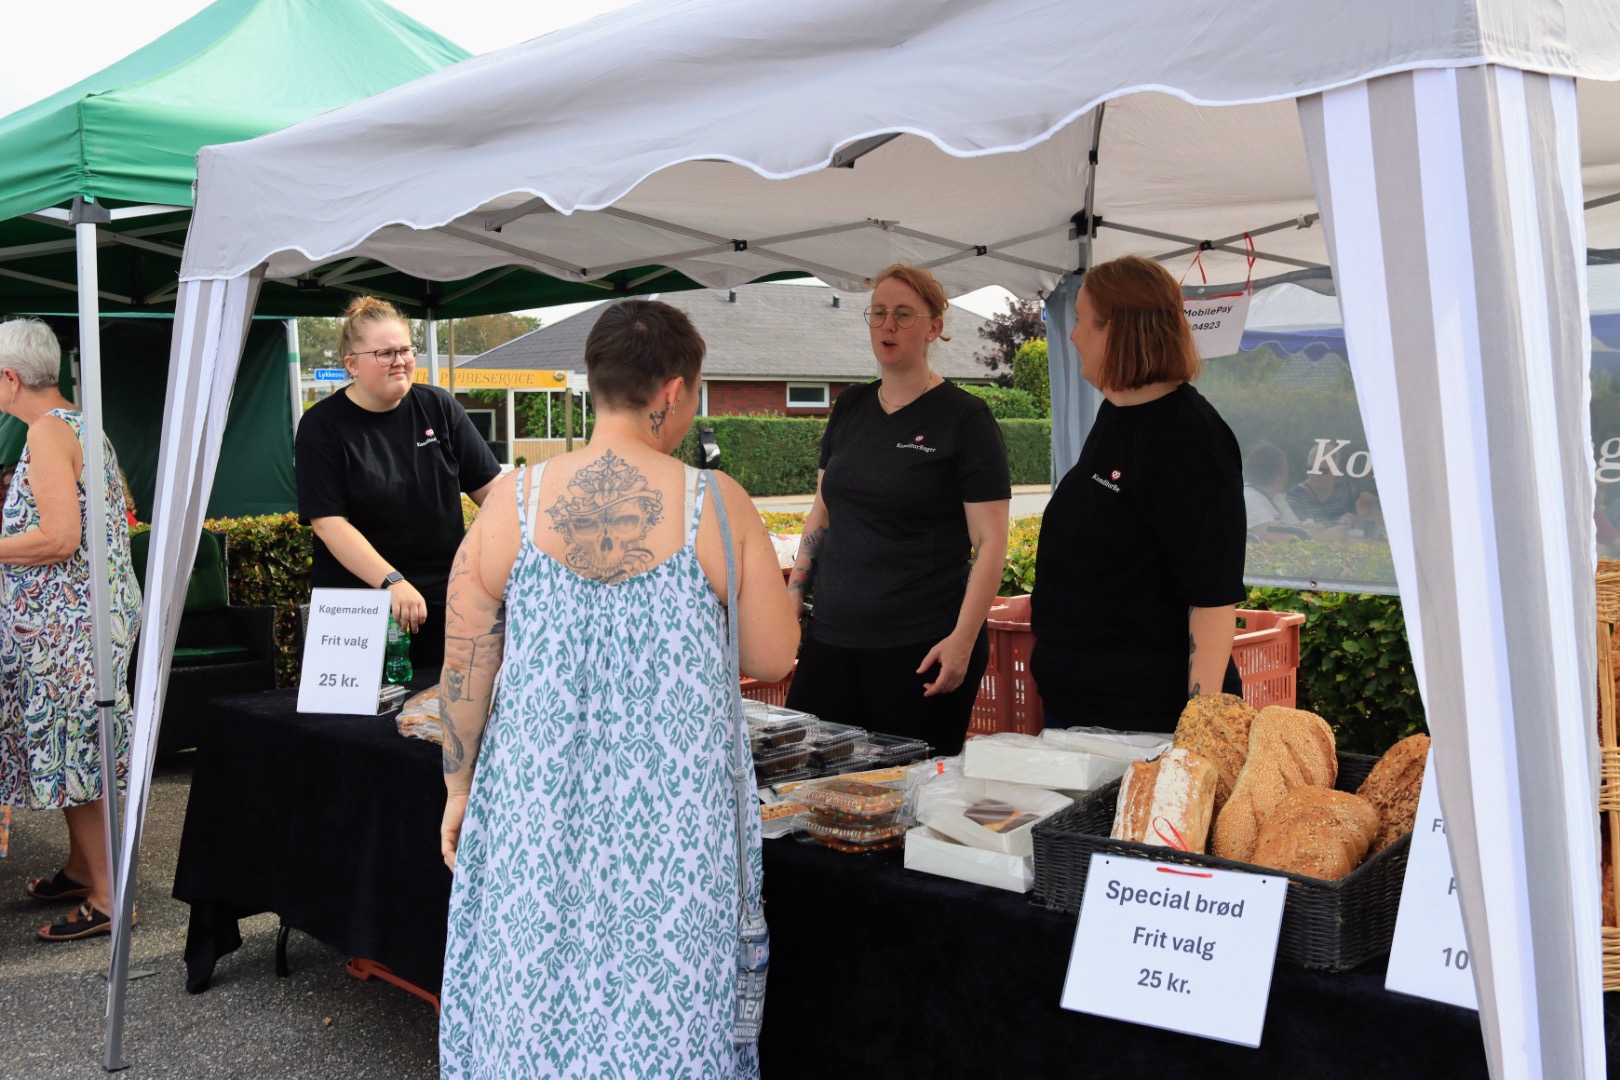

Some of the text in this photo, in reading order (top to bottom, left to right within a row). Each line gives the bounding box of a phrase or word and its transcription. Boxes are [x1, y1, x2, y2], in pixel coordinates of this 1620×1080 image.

[1183, 305, 1234, 317] MobilePay
[1189, 321, 1222, 331] 04923
[318, 604, 379, 615] Kagemarked
[321, 635, 369, 649] Frit valg
[318, 673, 359, 687] 25 kr.
[1105, 879, 1246, 919] Special brød
[1132, 926, 1217, 962] Frit valg
[1137, 968, 1192, 995] 25 kr.
